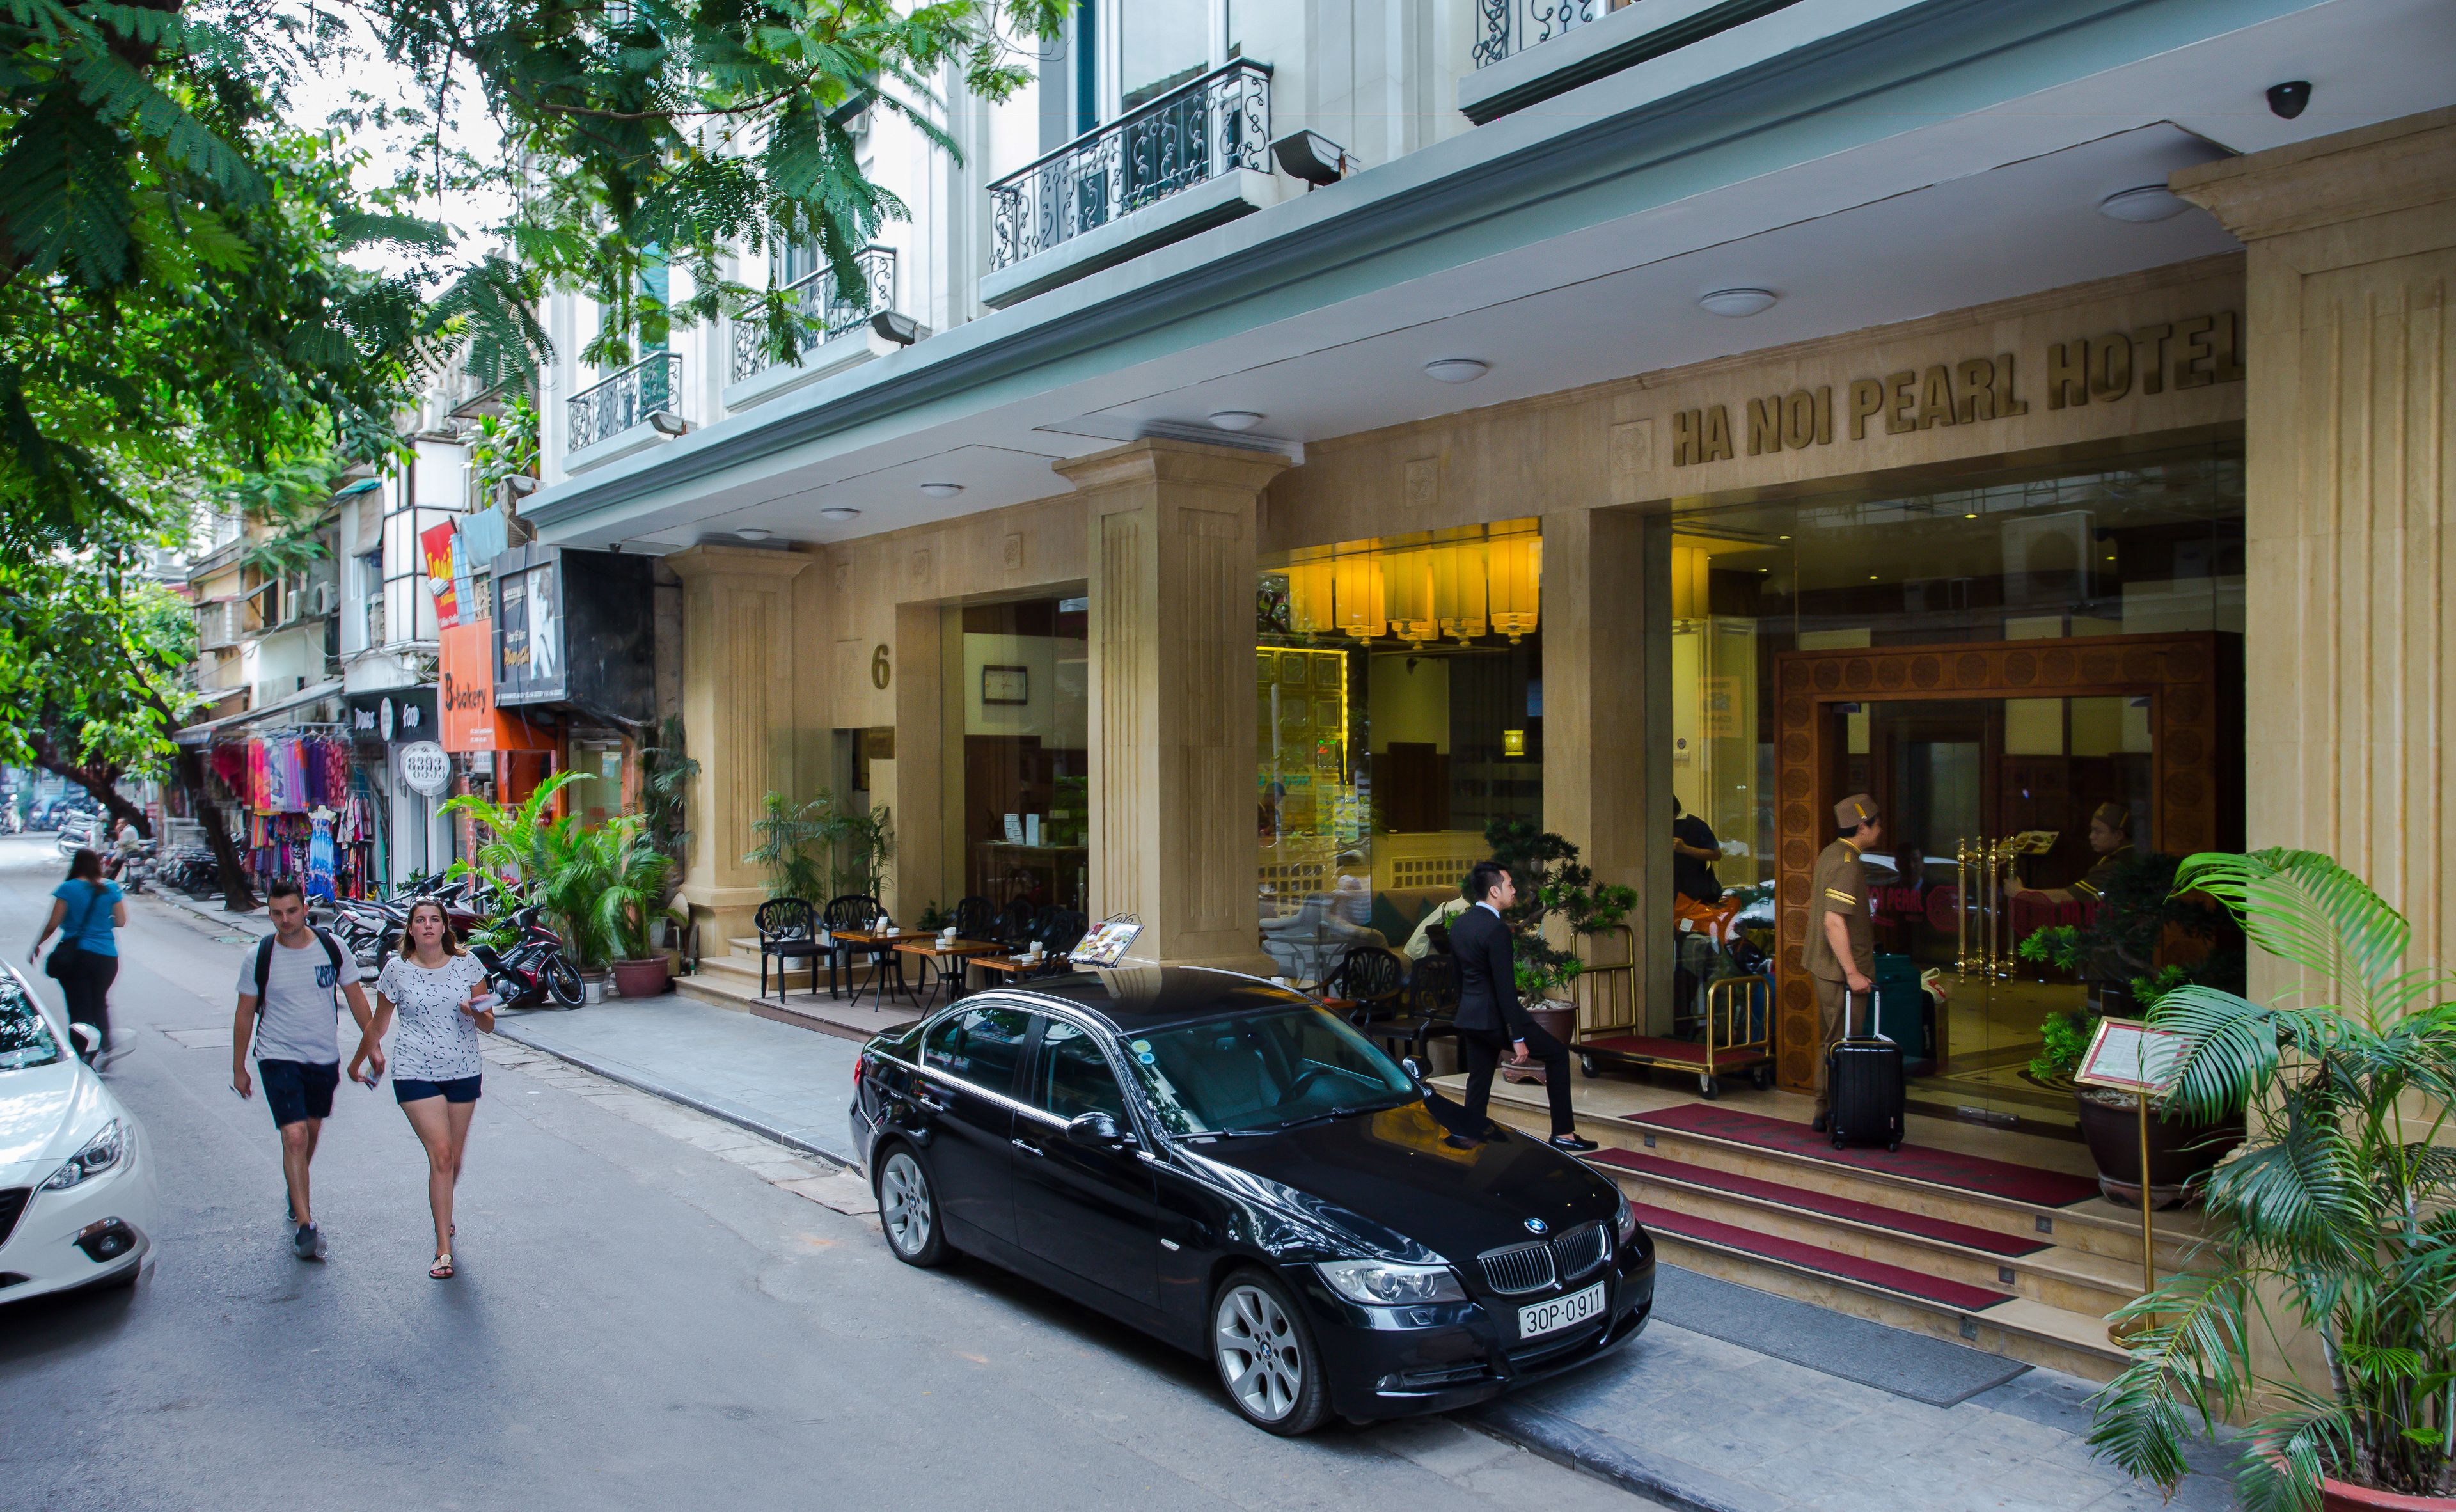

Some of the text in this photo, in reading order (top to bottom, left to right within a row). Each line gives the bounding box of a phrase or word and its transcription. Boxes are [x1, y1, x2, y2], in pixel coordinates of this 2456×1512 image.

[1673, 311, 2246, 467] HA NOI PEARL HOTEL
[871, 644, 891, 689] 6
[1887, 887, 1924, 913] PEARL
[1526, 1288, 1600, 1334] 30P-0911
